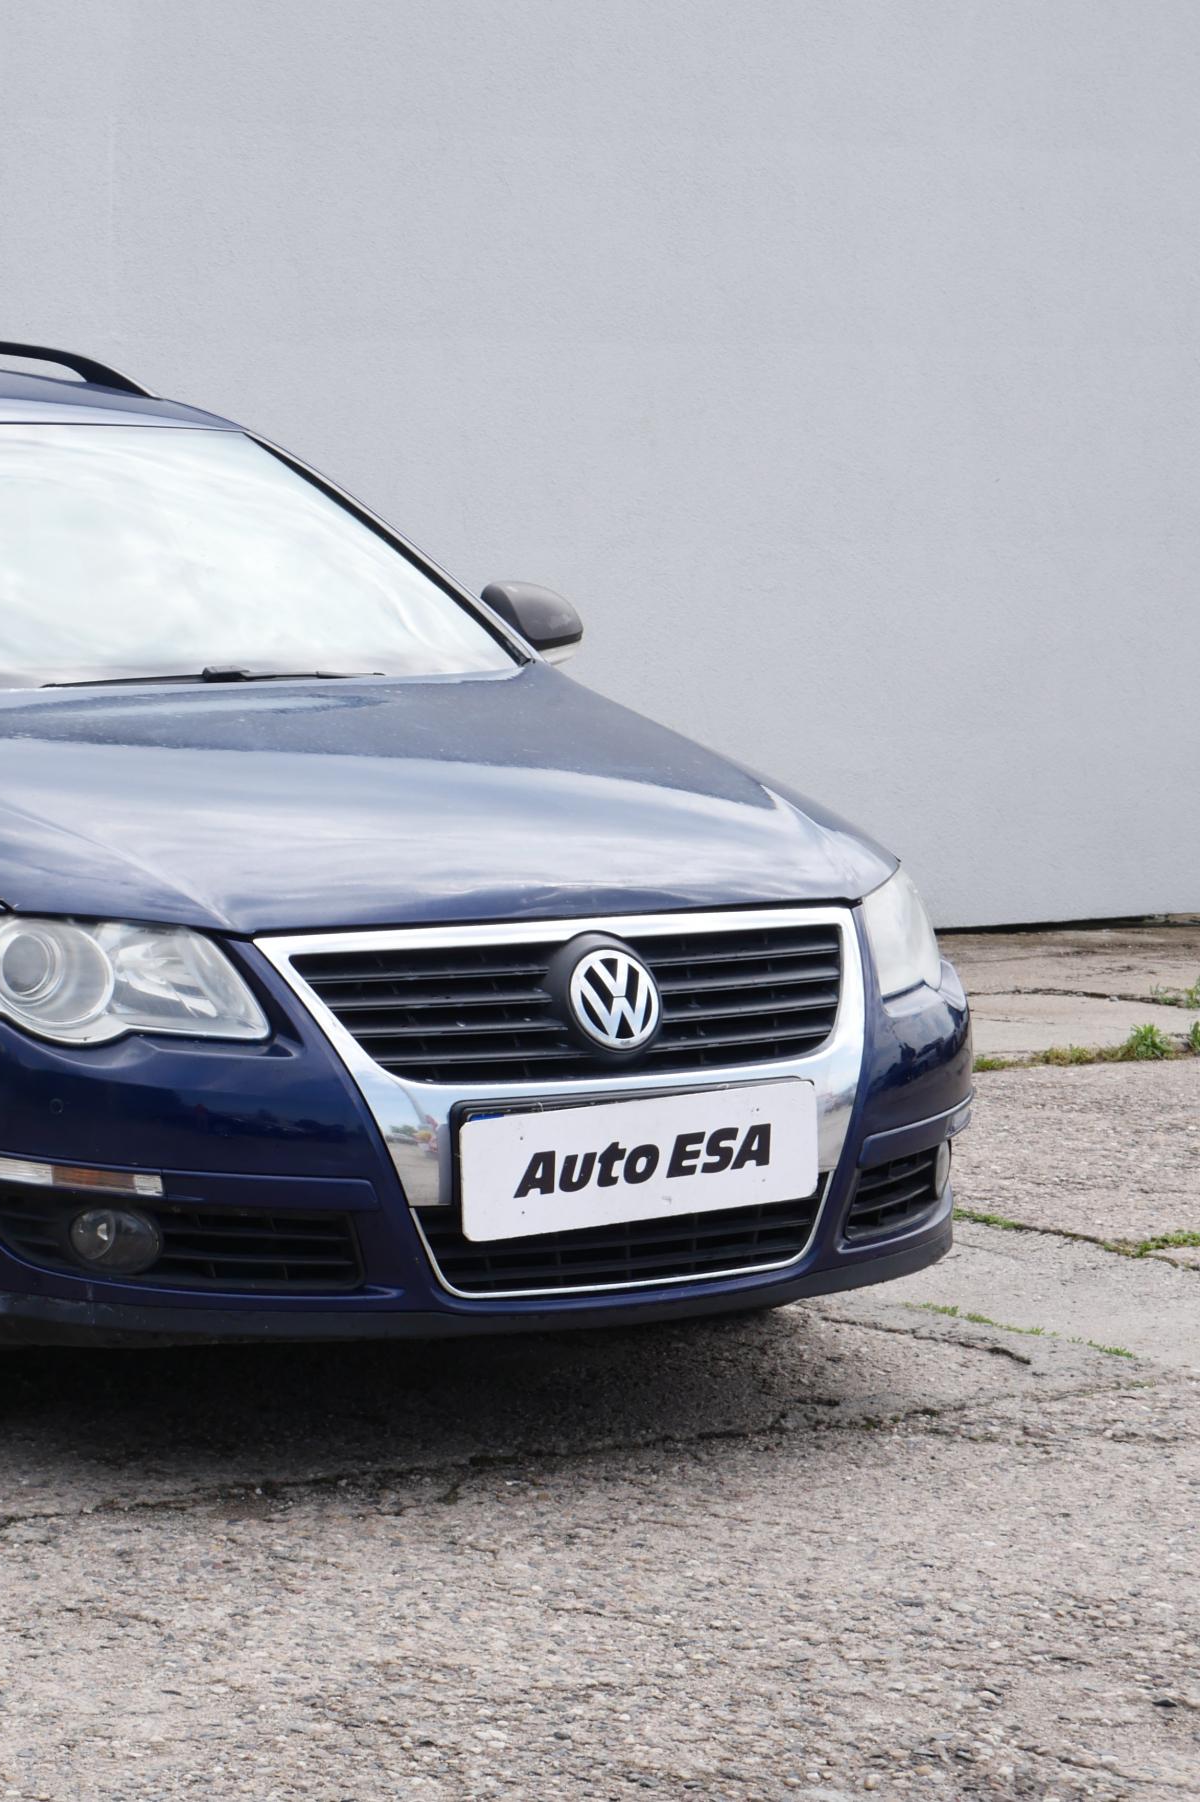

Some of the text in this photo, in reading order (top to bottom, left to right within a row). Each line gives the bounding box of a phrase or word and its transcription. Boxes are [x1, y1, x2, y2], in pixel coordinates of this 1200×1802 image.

[570, 949, 660, 1049] VW
[513, 1123, 772, 1199] Auto ESA
